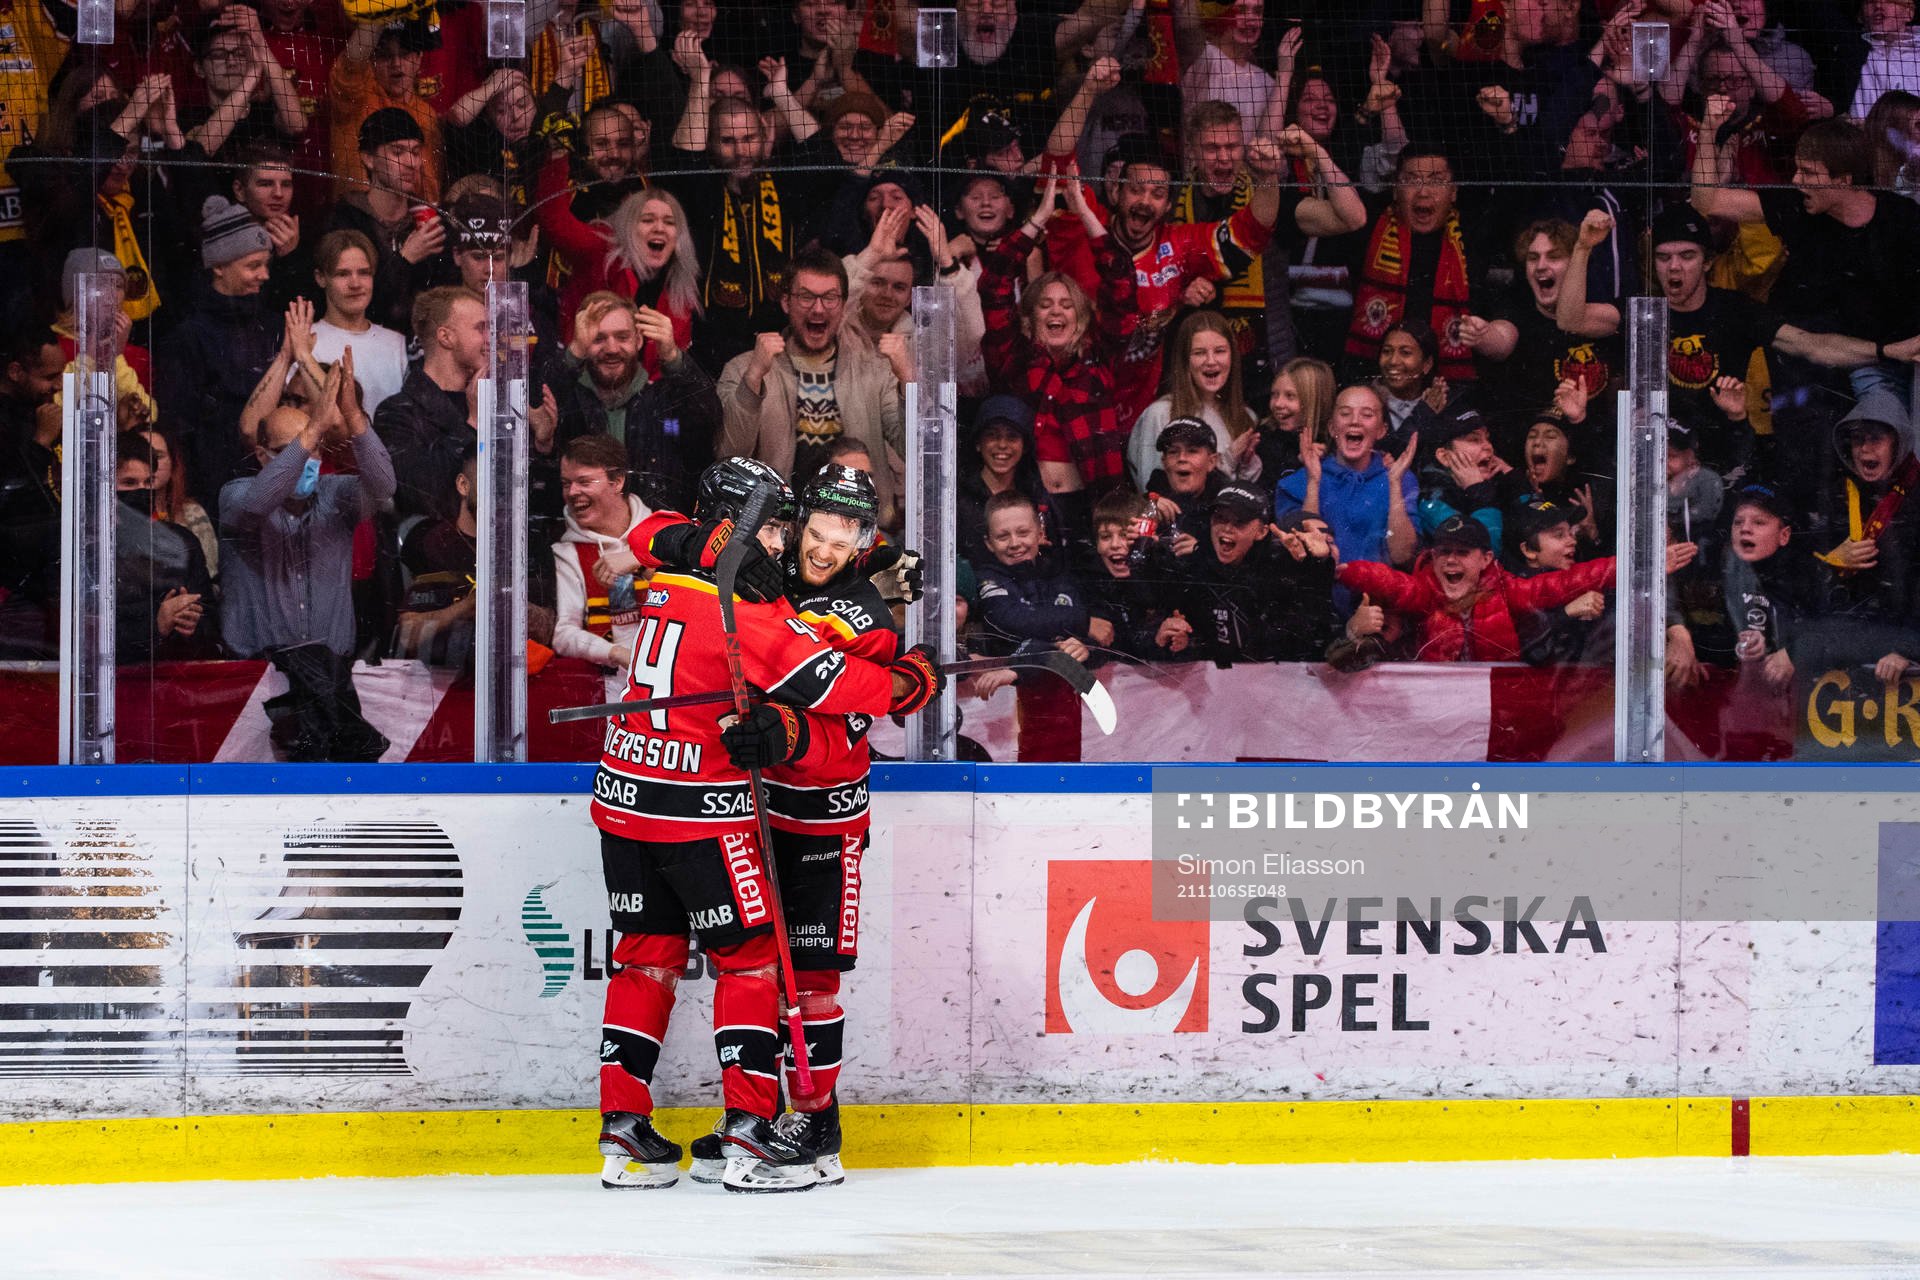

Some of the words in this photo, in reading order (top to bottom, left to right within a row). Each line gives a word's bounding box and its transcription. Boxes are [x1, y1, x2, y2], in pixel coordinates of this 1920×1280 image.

[739, 458, 764, 476] LKAB
[826, 599, 874, 630] SSAB
[785, 618, 821, 643] 4
[603, 721, 702, 774] DERSSON
[594, 771, 638, 806] SSAB
[828, 783, 868, 814] SSAB
[802, 851, 841, 862] BAUER
[723, 832, 767, 924] äiden
[841, 833, 862, 950] Näiden
[789, 922, 826, 934] Luleå
[1243, 895, 1608, 957] SVENSKA
[789, 937, 834, 948] Energi
[1242, 973, 1430, 1034] SPEL
